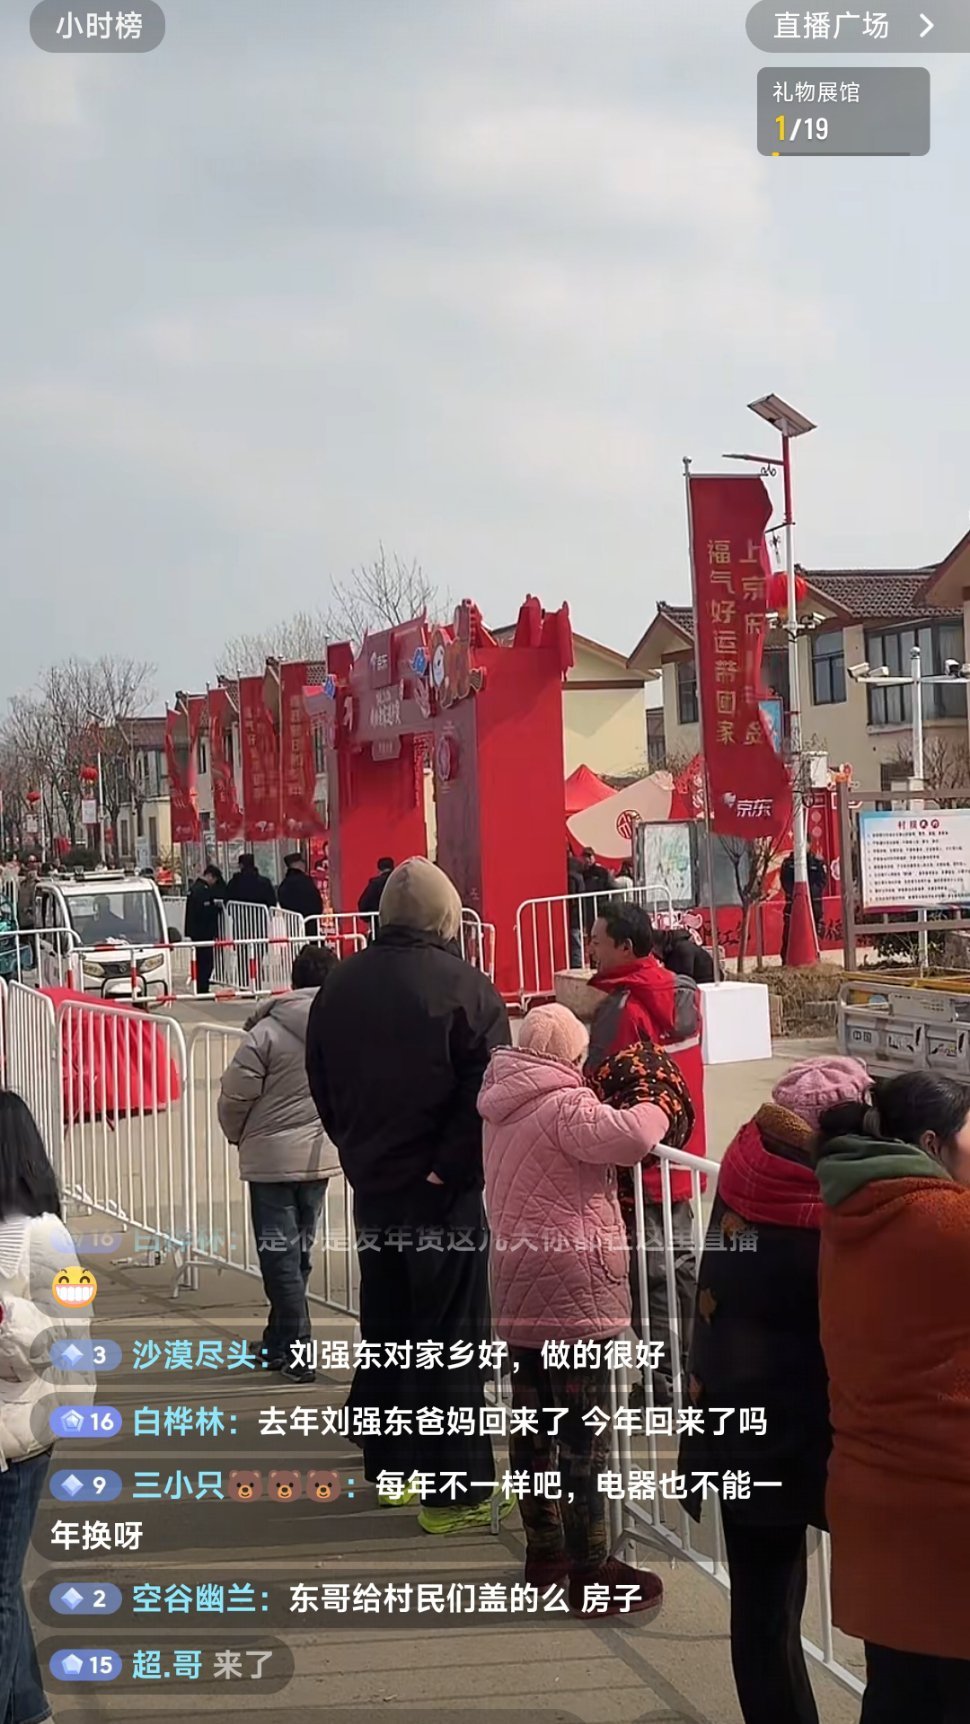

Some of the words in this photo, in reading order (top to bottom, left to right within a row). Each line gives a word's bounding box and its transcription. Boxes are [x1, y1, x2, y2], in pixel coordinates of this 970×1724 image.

[707, 539, 740, 746] 福气好运带回家
[736, 798, 773, 817] 京东
